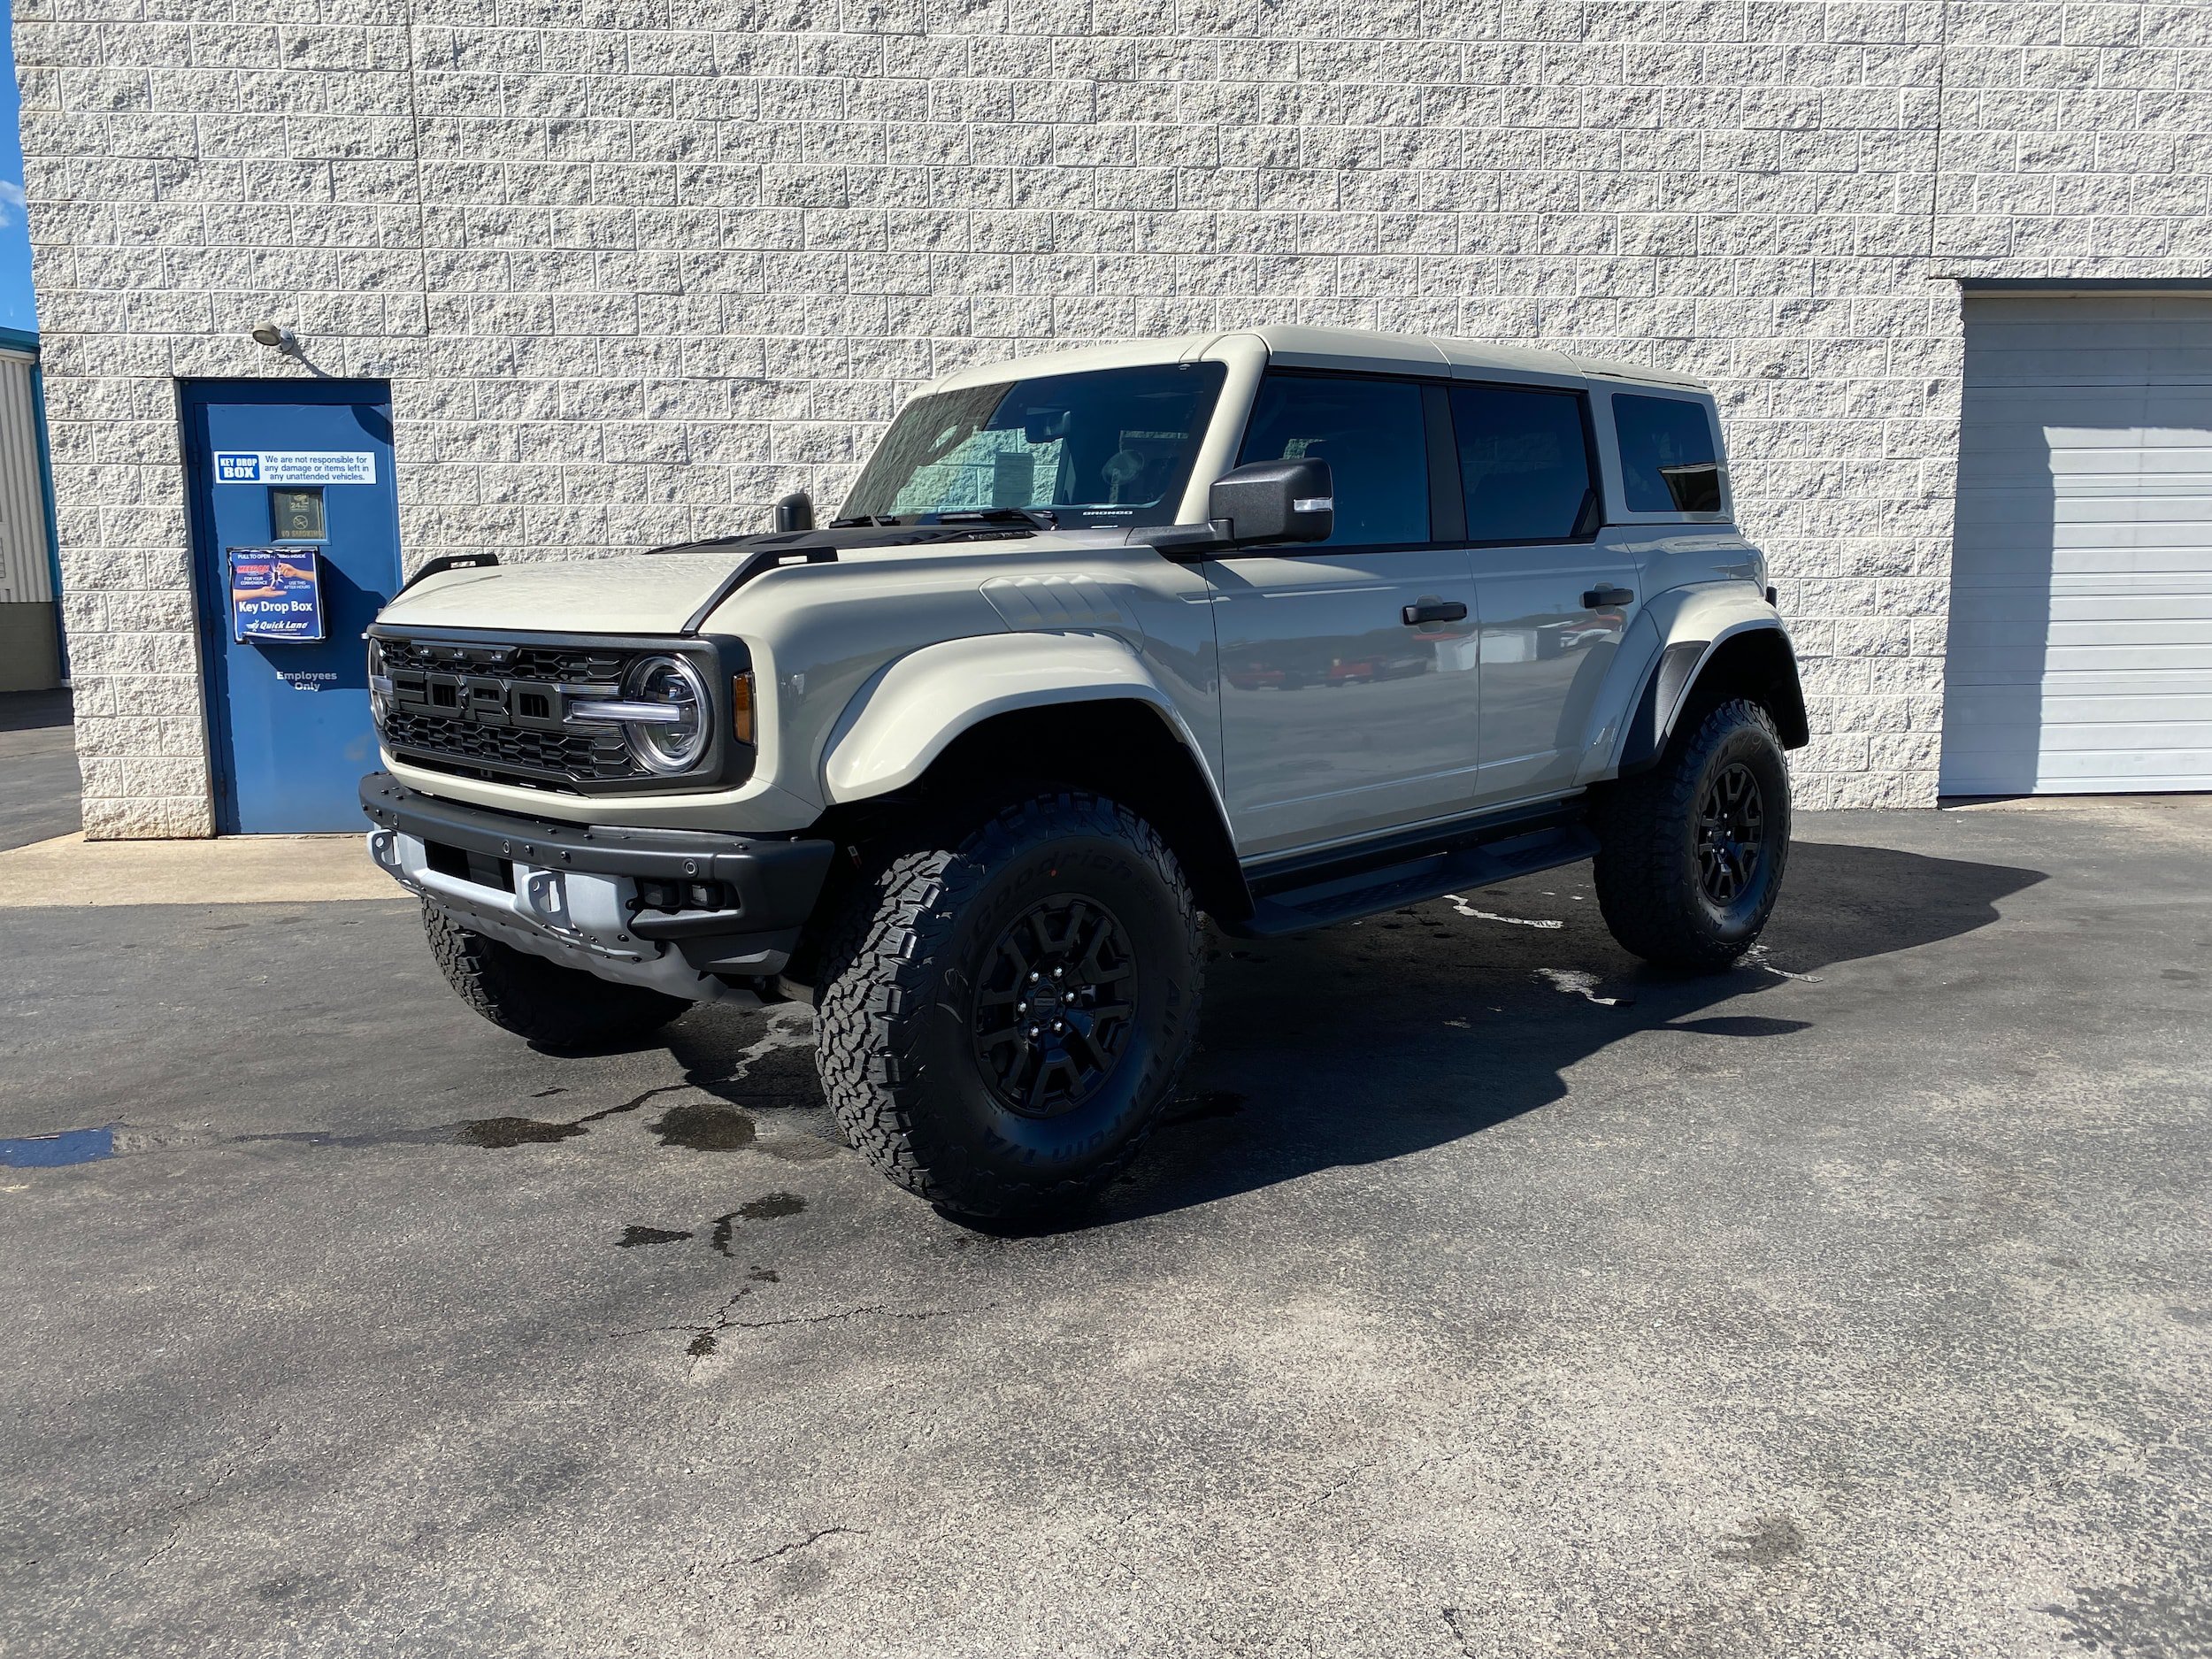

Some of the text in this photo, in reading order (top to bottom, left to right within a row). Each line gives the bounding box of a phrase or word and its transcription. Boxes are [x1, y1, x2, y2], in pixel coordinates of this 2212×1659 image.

[219, 457, 257, 466] KEY DROP
[265, 455, 278, 464] We
[310, 455, 354, 465] responsible
[223, 466, 255, 479] BOX
[280, 465, 312, 473] damage
[239, 601, 313, 615] Key Drop Box
[259, 619, 308, 630] Quick Lane
[276, 671, 338, 681] Employees
[295, 681, 320, 692] Only
[391, 668, 563, 733] FORD
